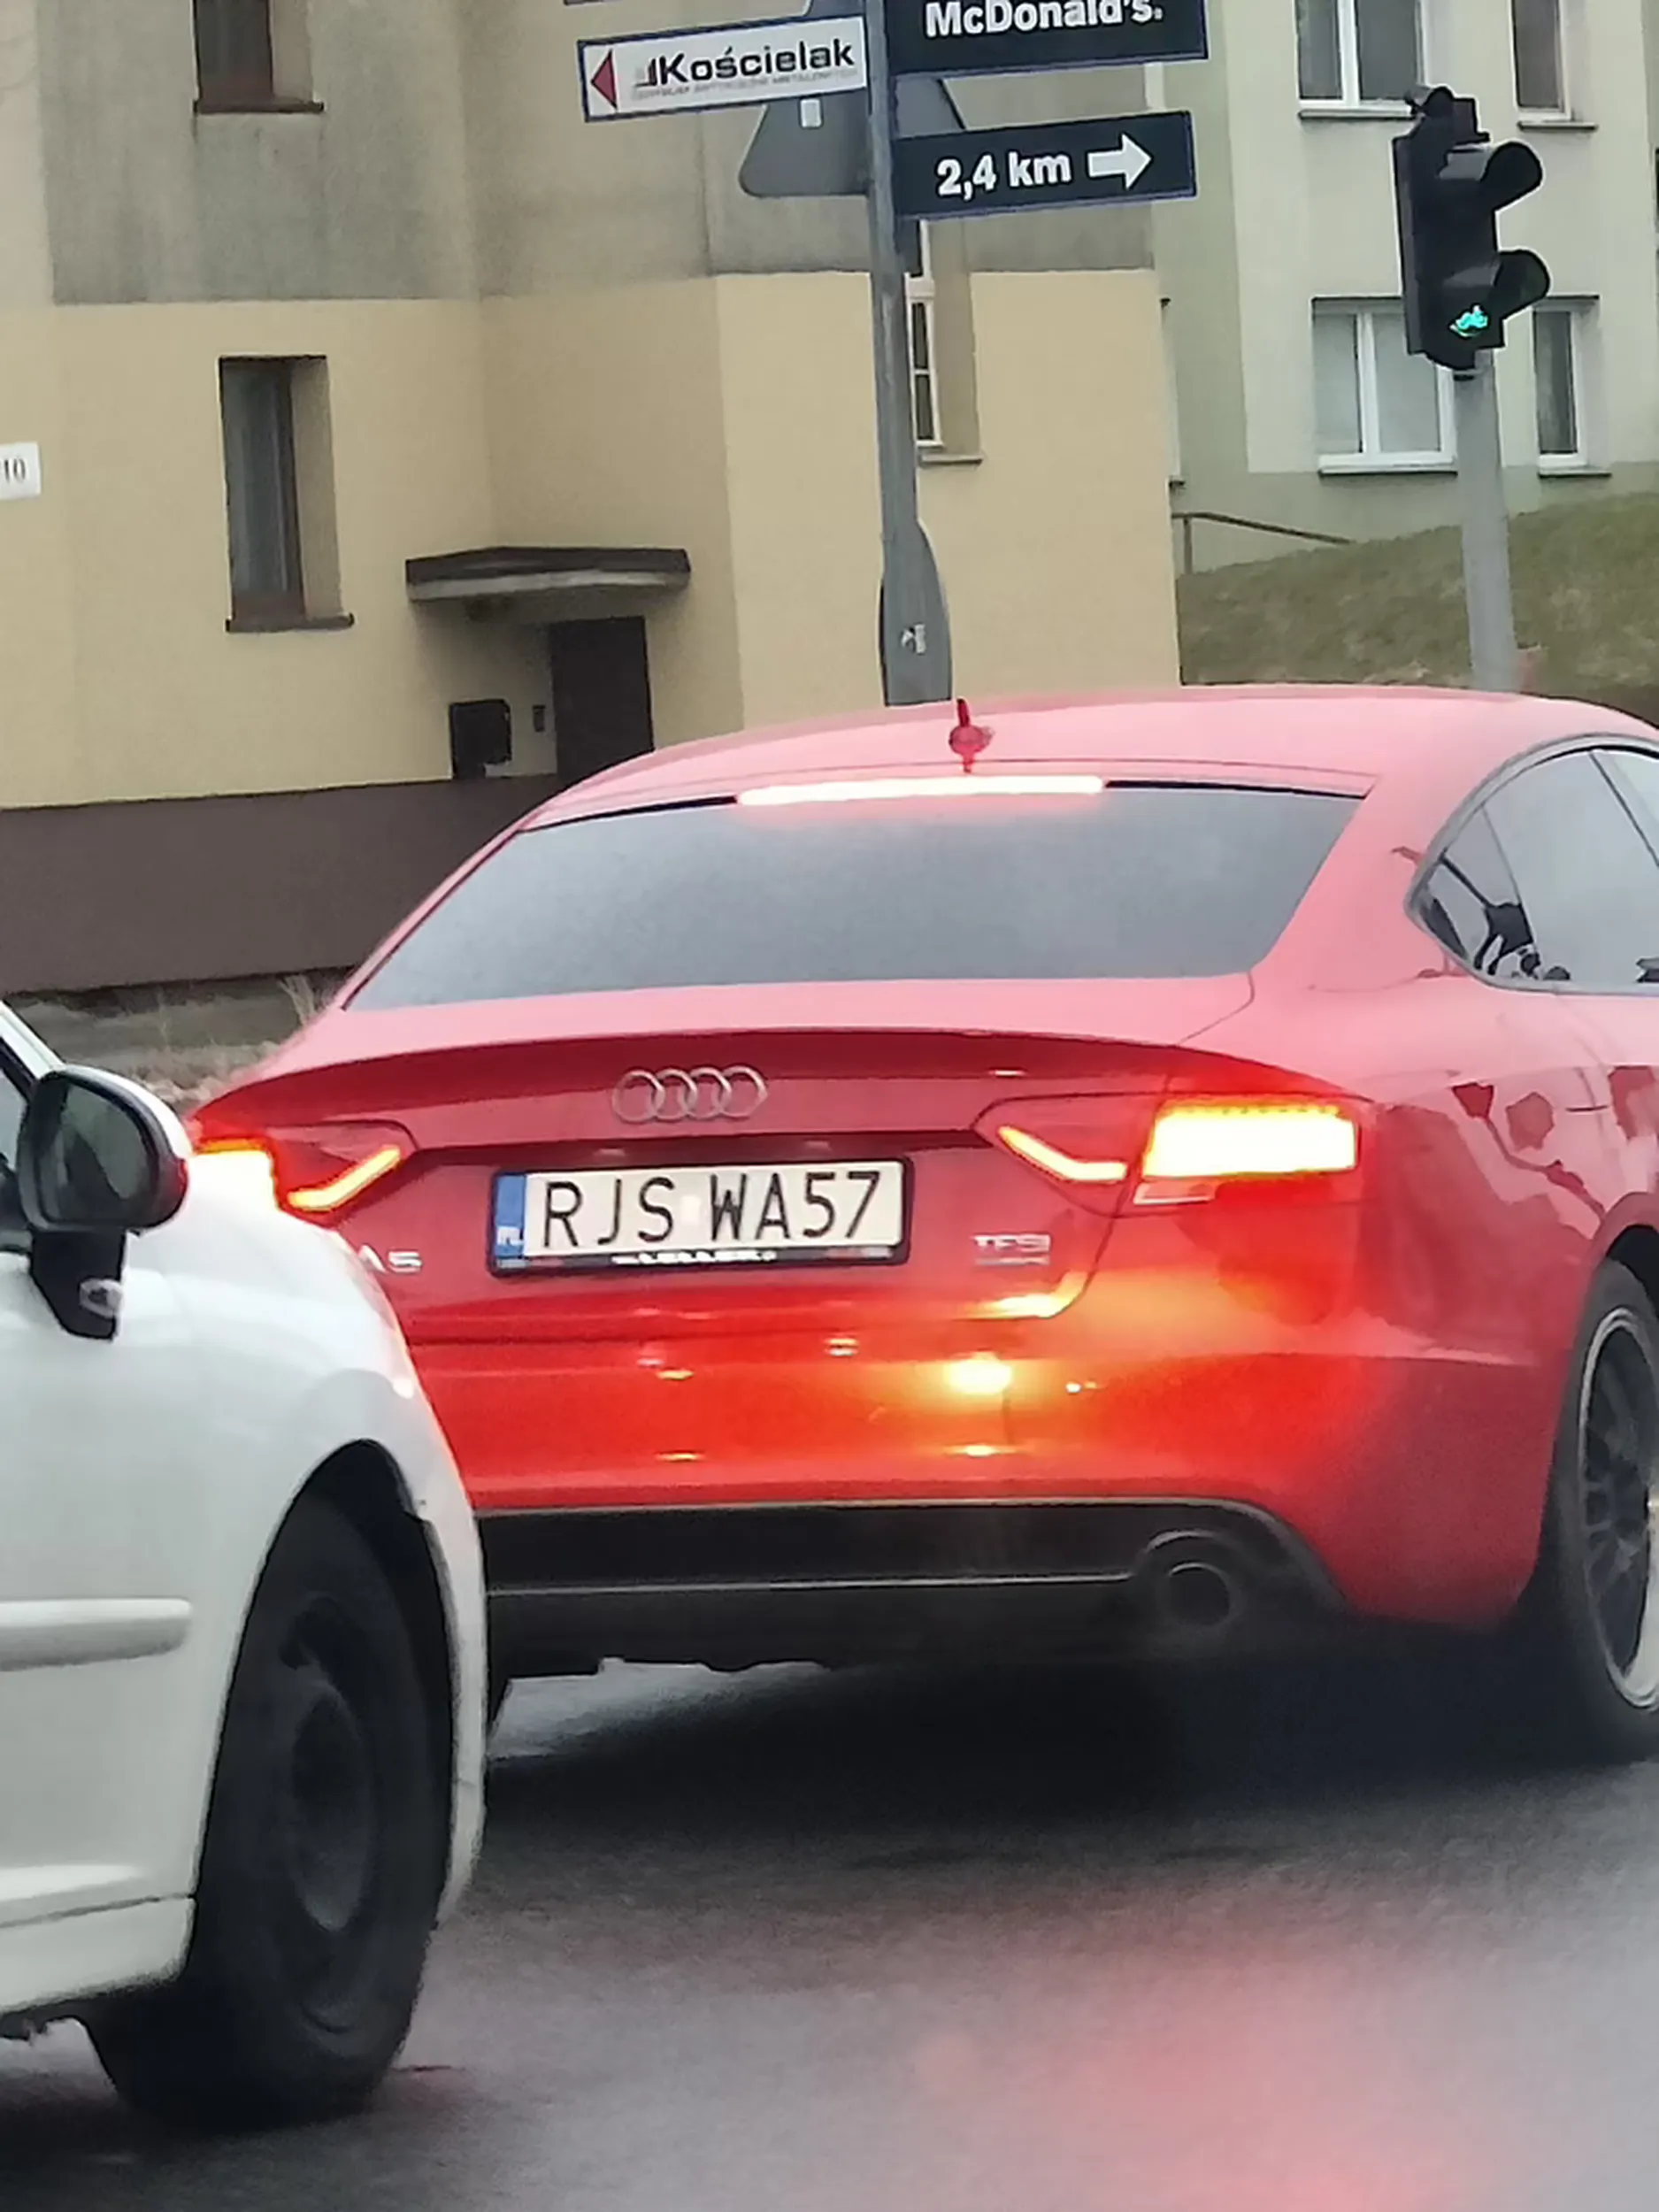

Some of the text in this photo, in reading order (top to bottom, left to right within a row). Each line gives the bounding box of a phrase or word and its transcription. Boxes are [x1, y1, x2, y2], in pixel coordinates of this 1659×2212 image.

[937, 152, 1071, 200] 2,4 km
[544, 1171, 880, 1248] RJS WA57
